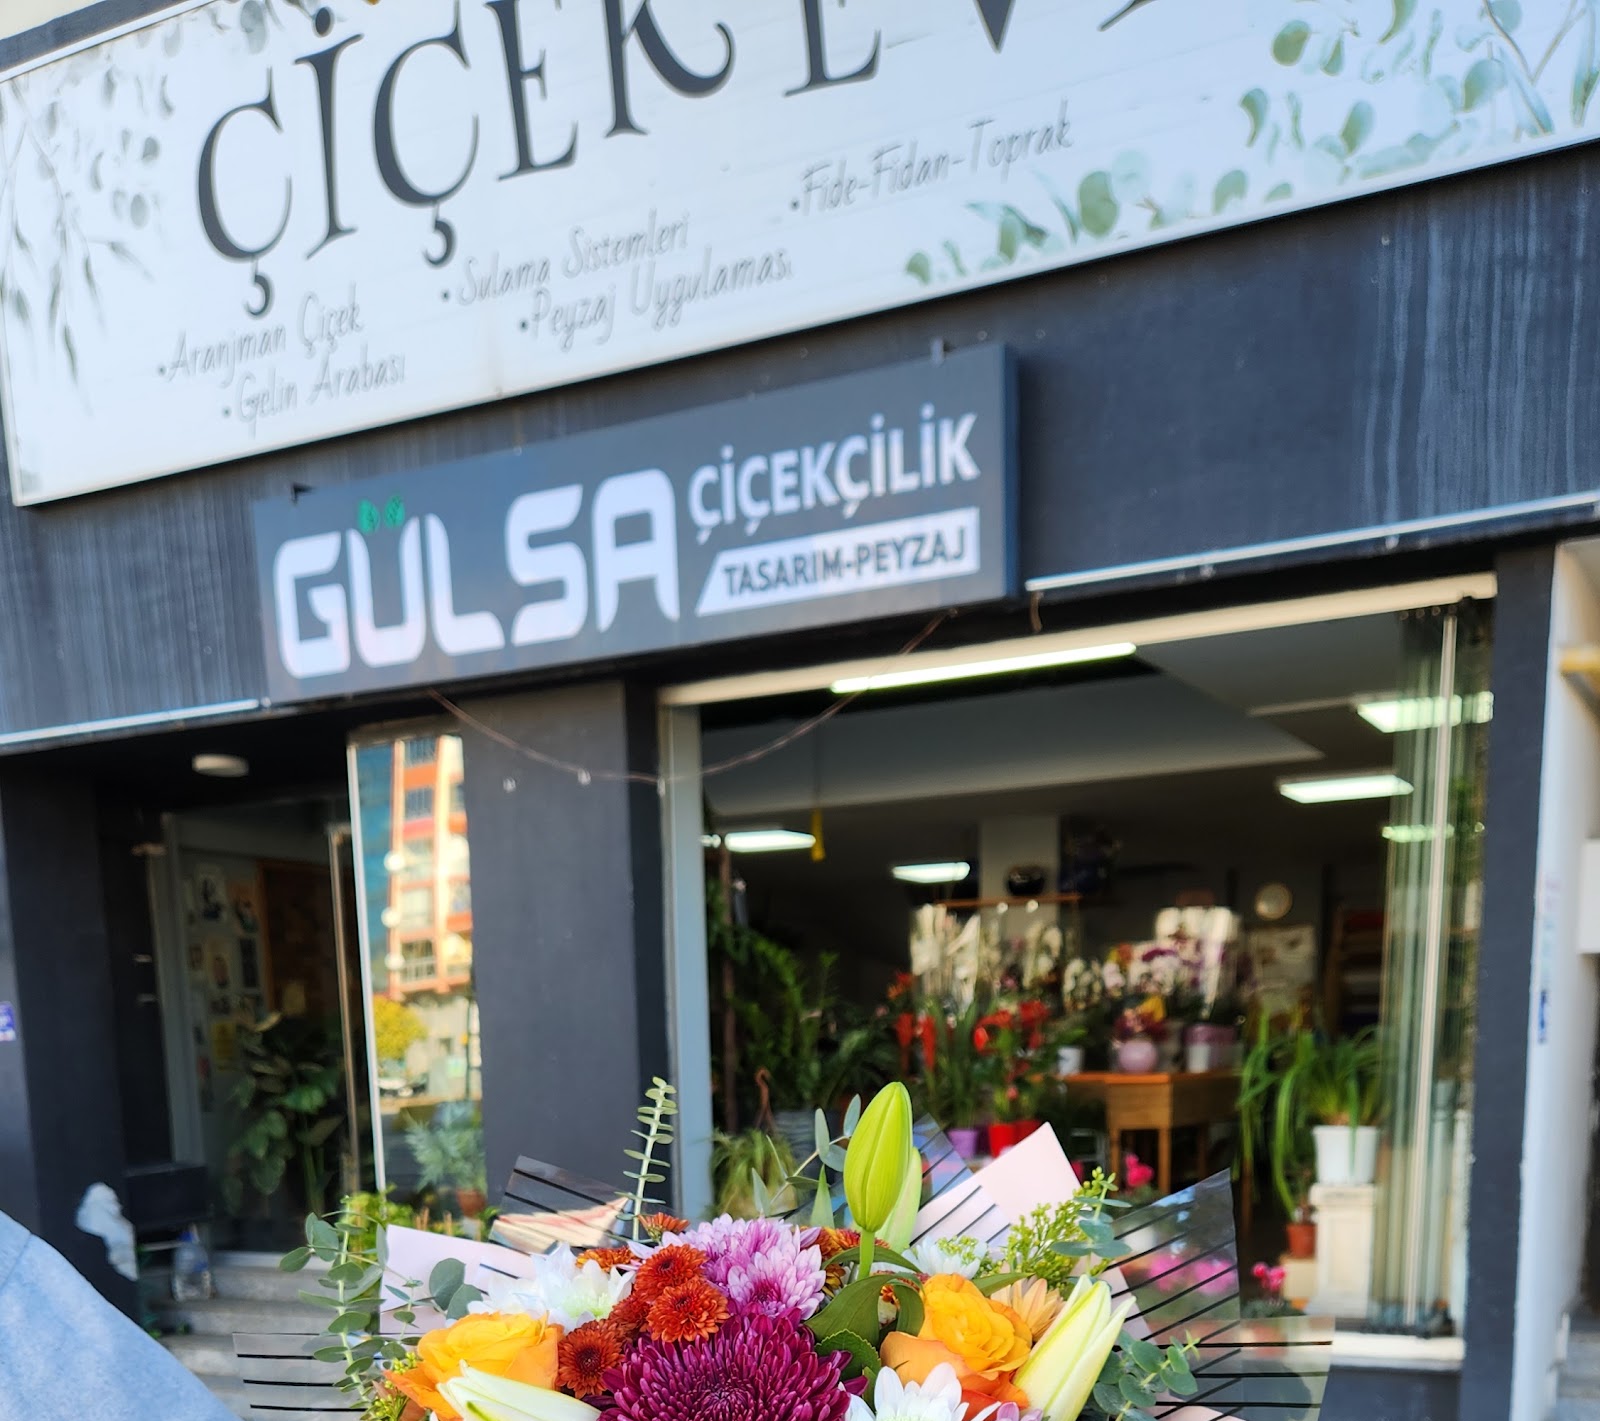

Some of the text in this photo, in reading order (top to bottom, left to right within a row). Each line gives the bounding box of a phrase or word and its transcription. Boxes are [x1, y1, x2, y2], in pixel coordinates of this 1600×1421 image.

[197, 0, 735, 316] ÇİÇEK
[458, 207, 690, 306] Sulama Sistemleri
[530, 244, 793, 353] Peyzaj Uygulaması
[167, 278, 364, 390] Aranjman Çiçek
[235, 340, 407, 440] Gelin Arabası
[688, 401, 982, 546] ÇİÇEKÇİLİK
[272, 466, 682, 680] GÜLSA
[721, 524, 968, 598] TASARIM-PEYZAJ
